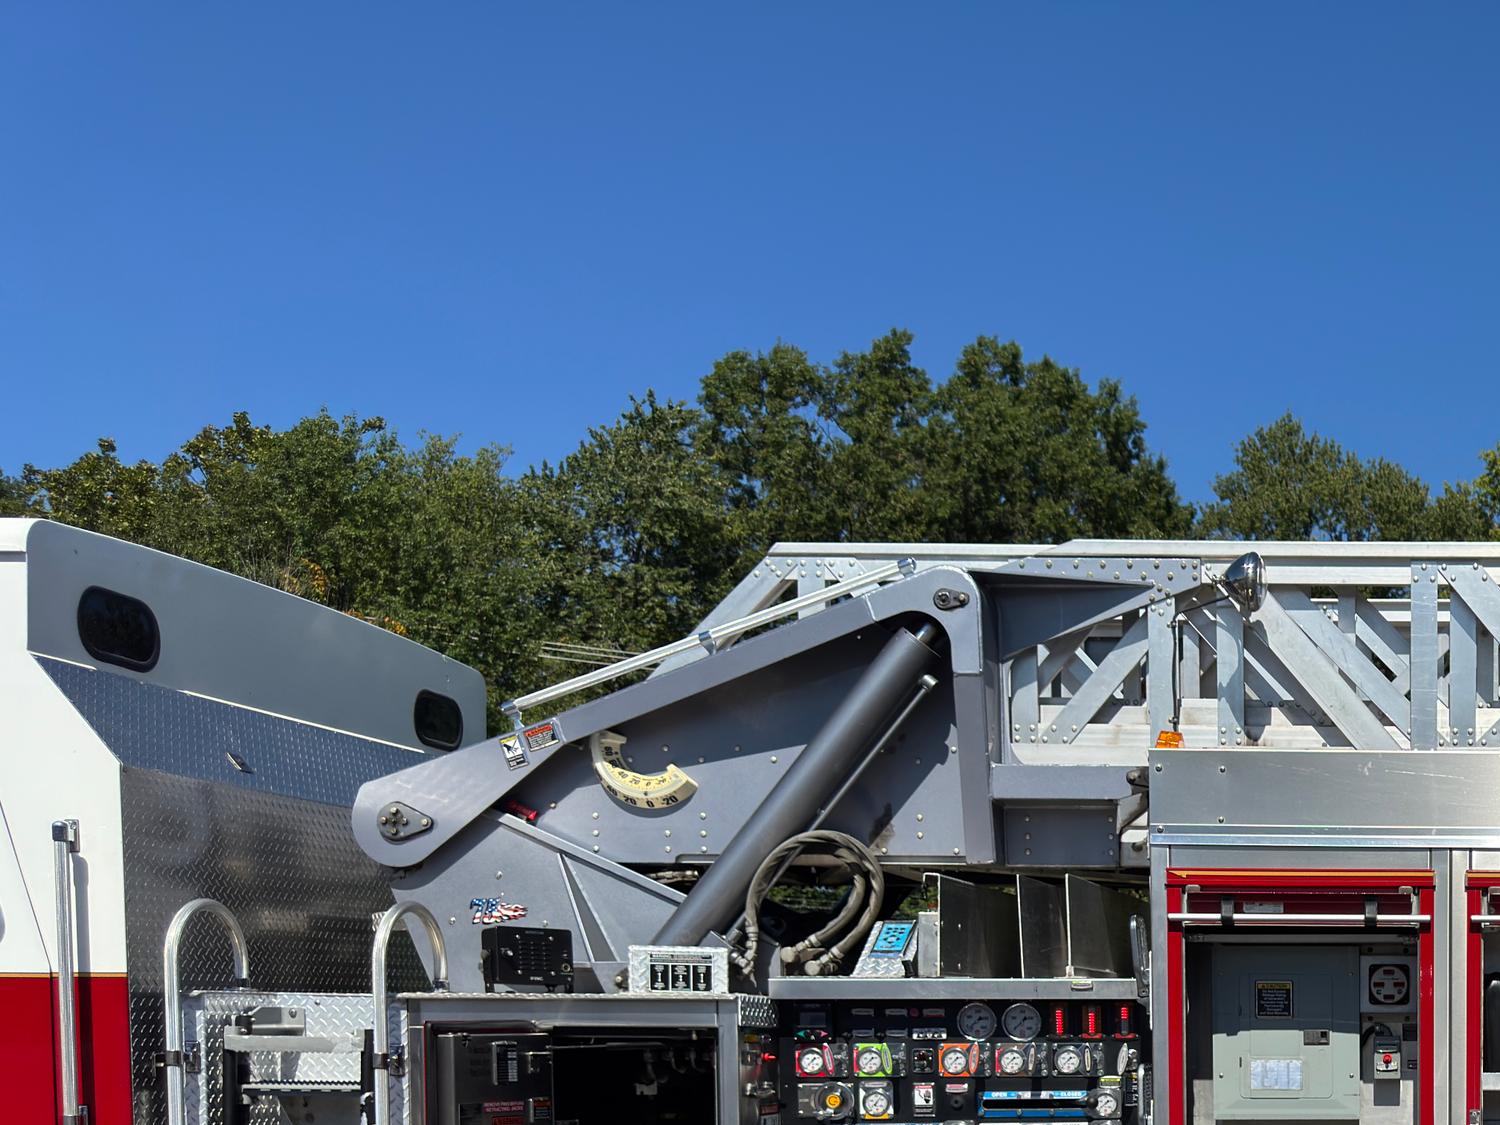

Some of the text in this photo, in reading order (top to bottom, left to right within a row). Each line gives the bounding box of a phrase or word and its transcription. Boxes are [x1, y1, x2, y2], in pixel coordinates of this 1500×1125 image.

[623, 795, 637, 806] 20
[646, 800, 655, 808] 0
[661, 795, 679, 806] -20
